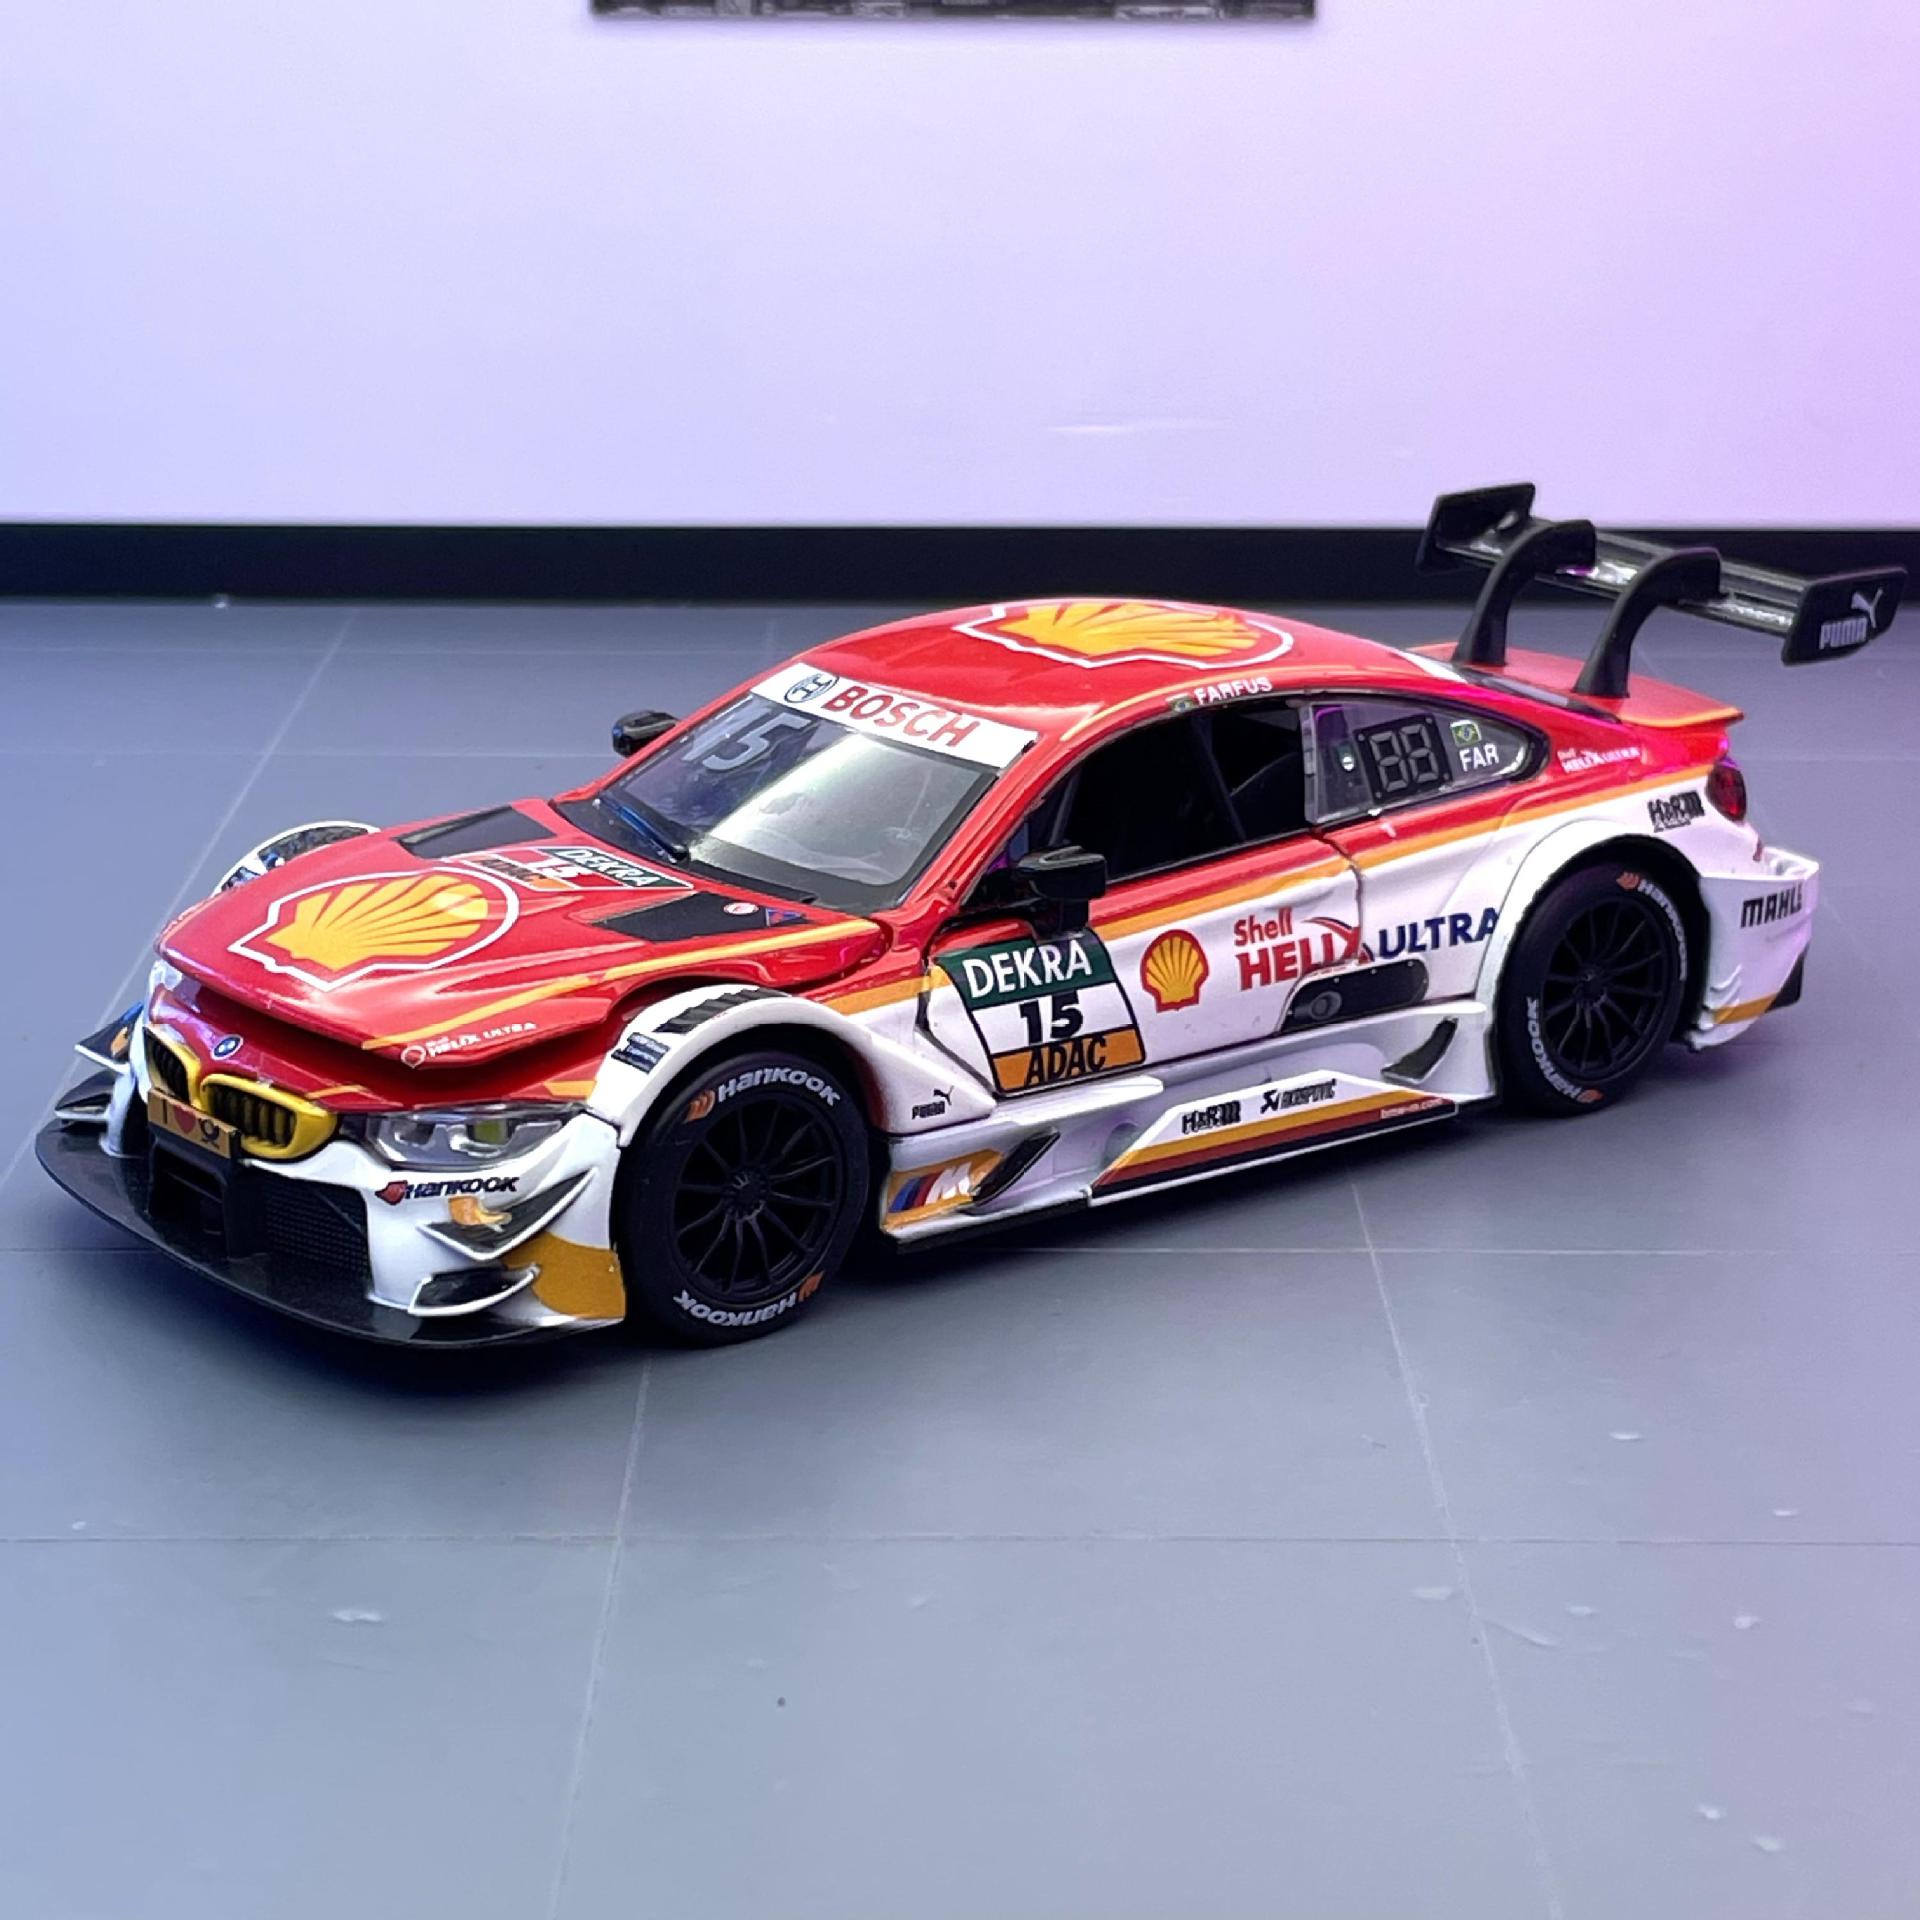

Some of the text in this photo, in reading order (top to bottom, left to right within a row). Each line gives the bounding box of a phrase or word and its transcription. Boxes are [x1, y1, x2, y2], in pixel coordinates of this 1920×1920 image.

[821, 685, 981, 748] BOSCH
[1193, 676, 1273, 706] FARFUS
[681, 705, 812, 771] 15
[1459, 743, 1500, 772] FAR
[557, 849, 661, 888] DEKRA
[1233, 906, 1293, 947] Shell
[1235, 907, 1500, 991] HELIX ULTRA
[962, 940, 1093, 998] DEKRA
[1019, 990, 1084, 1046] 15
[1023, 1037, 1107, 1088] ADAC
